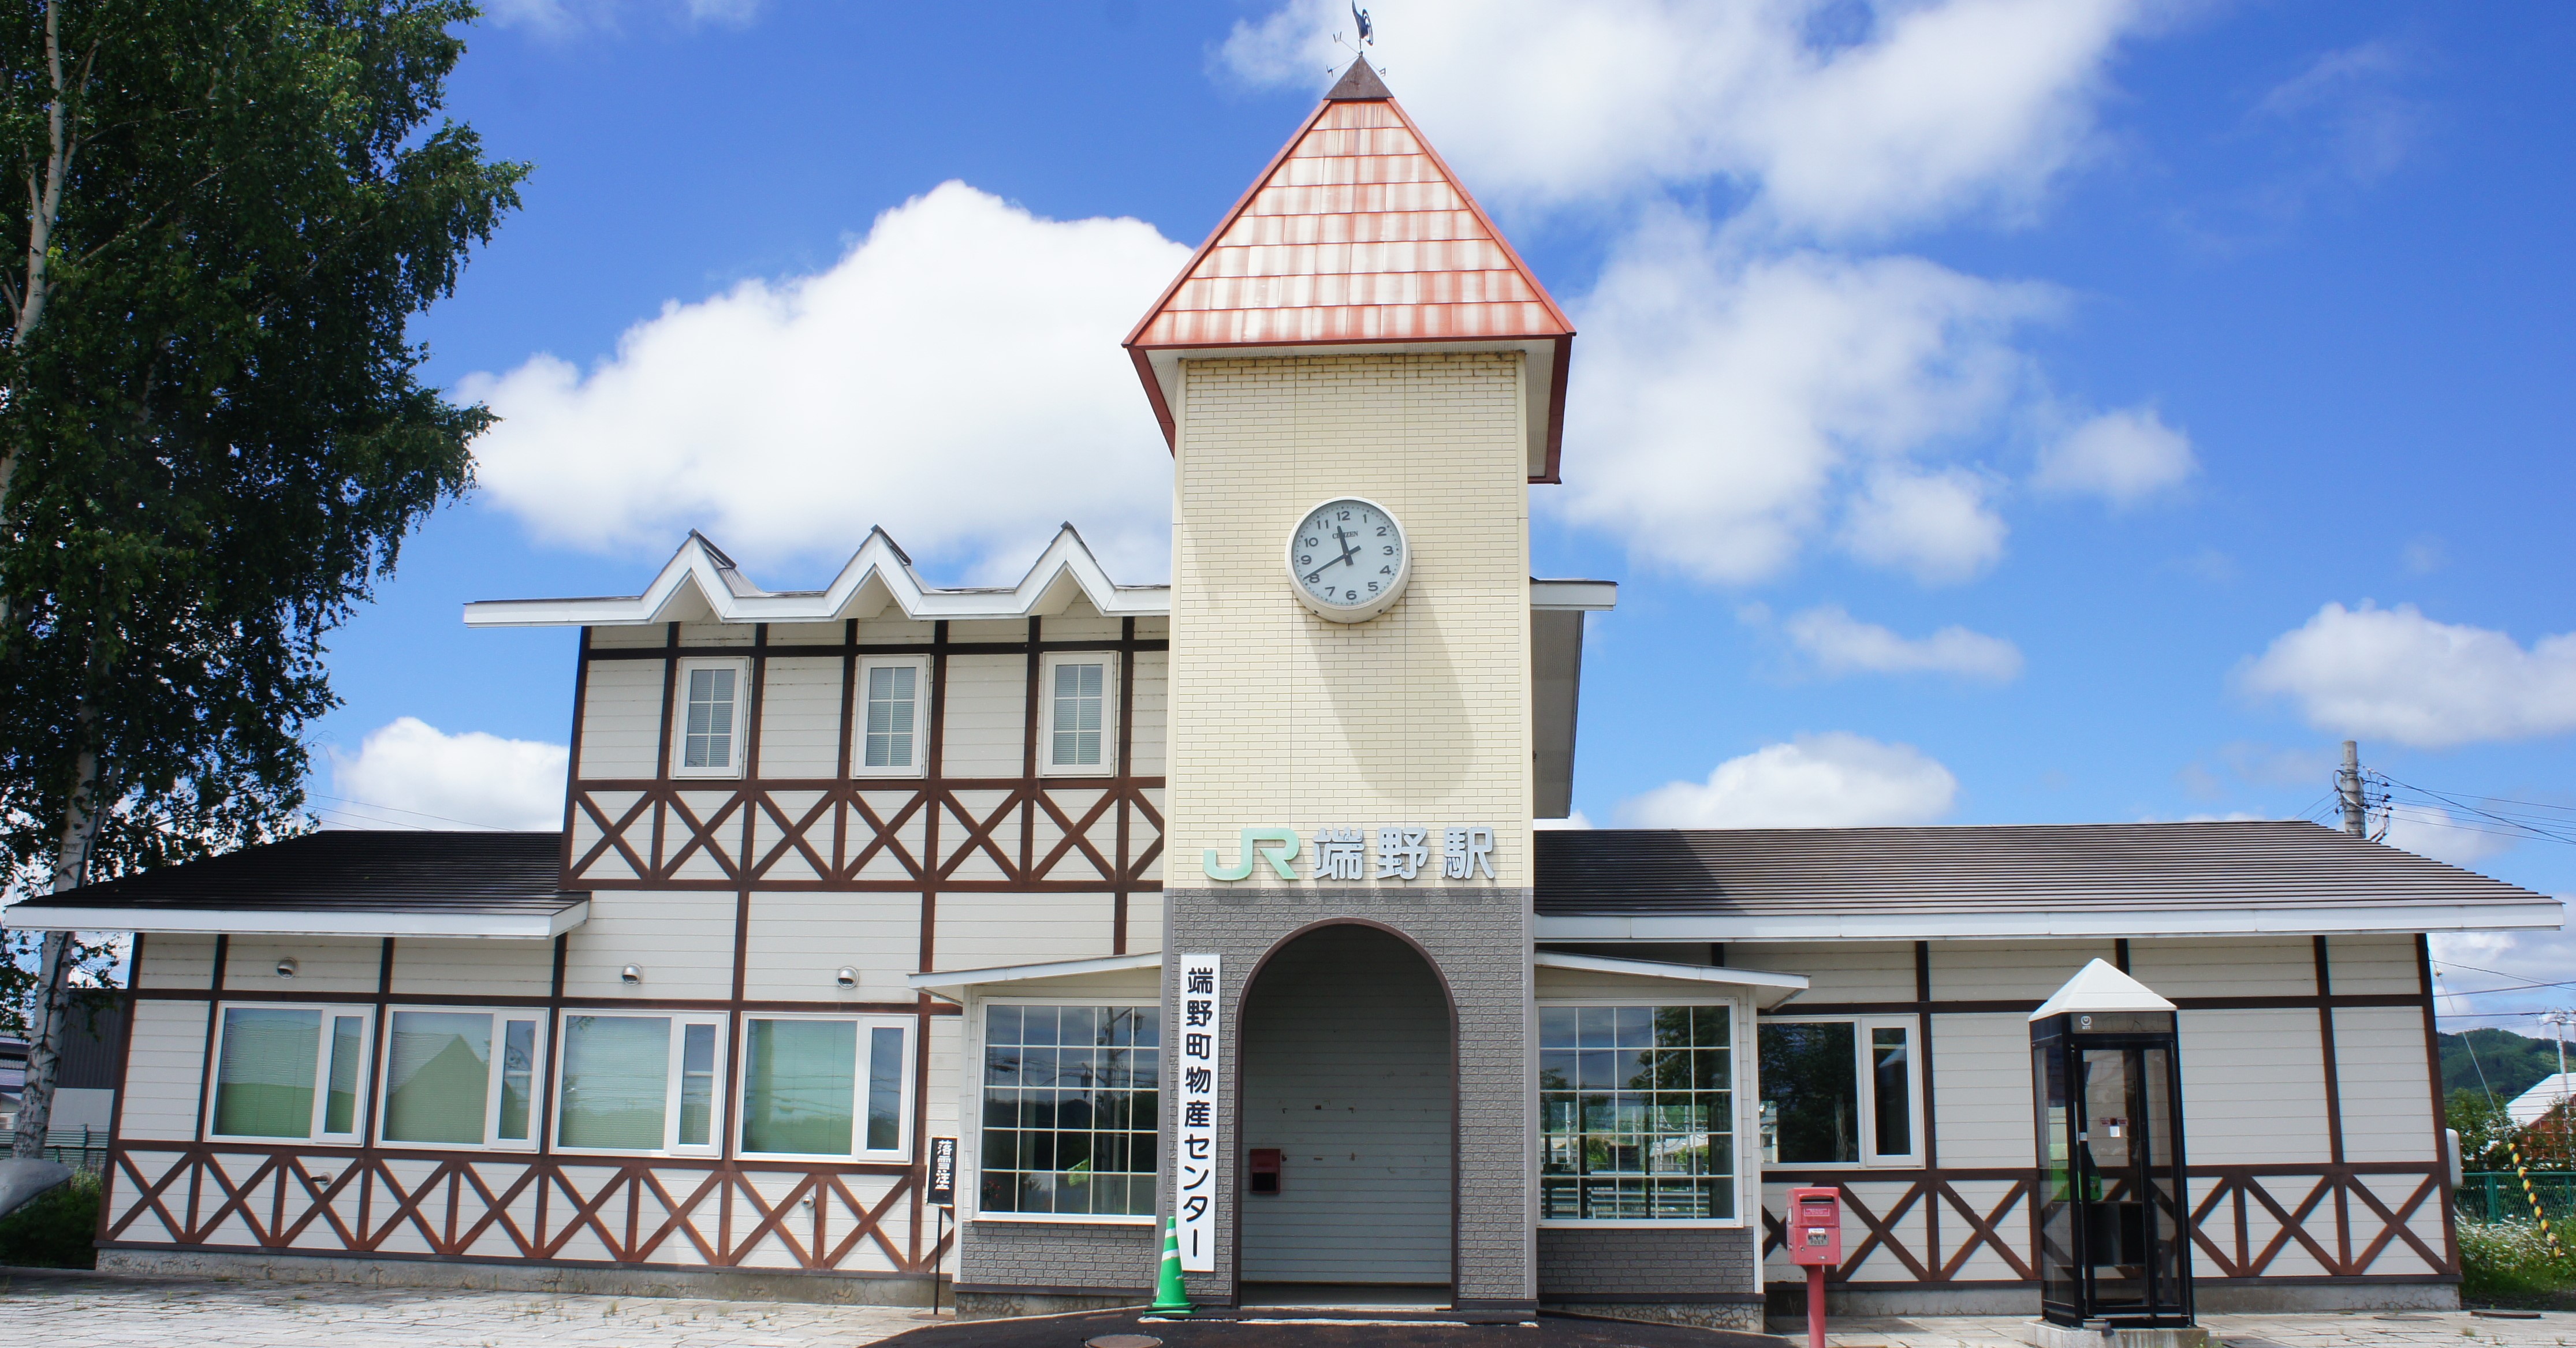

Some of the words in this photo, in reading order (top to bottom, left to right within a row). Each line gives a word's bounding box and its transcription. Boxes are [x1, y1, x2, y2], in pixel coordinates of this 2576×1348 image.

[1336, 510, 1350, 521] 12
[1363, 514, 1367, 524] 1
[1317, 520, 1329, 529] 11
[1376, 526, 1386, 536] 2
[1304, 537, 1318, 547] 10
[1382, 546, 1394, 555] 3
[1300, 555, 1312, 565] 9
[1379, 565, 1392, 575] 4
[1308, 573, 1320, 583] 8
[1325, 586, 1336, 596] 7
[1367, 581, 1378, 591] 5
[1345, 590, 1357, 600] 6
[1203, 827, 1299, 880] JR
[1313, 826, 1495, 880] 端野駅
[1183, 966, 1214, 1257] 端野町物産センター
